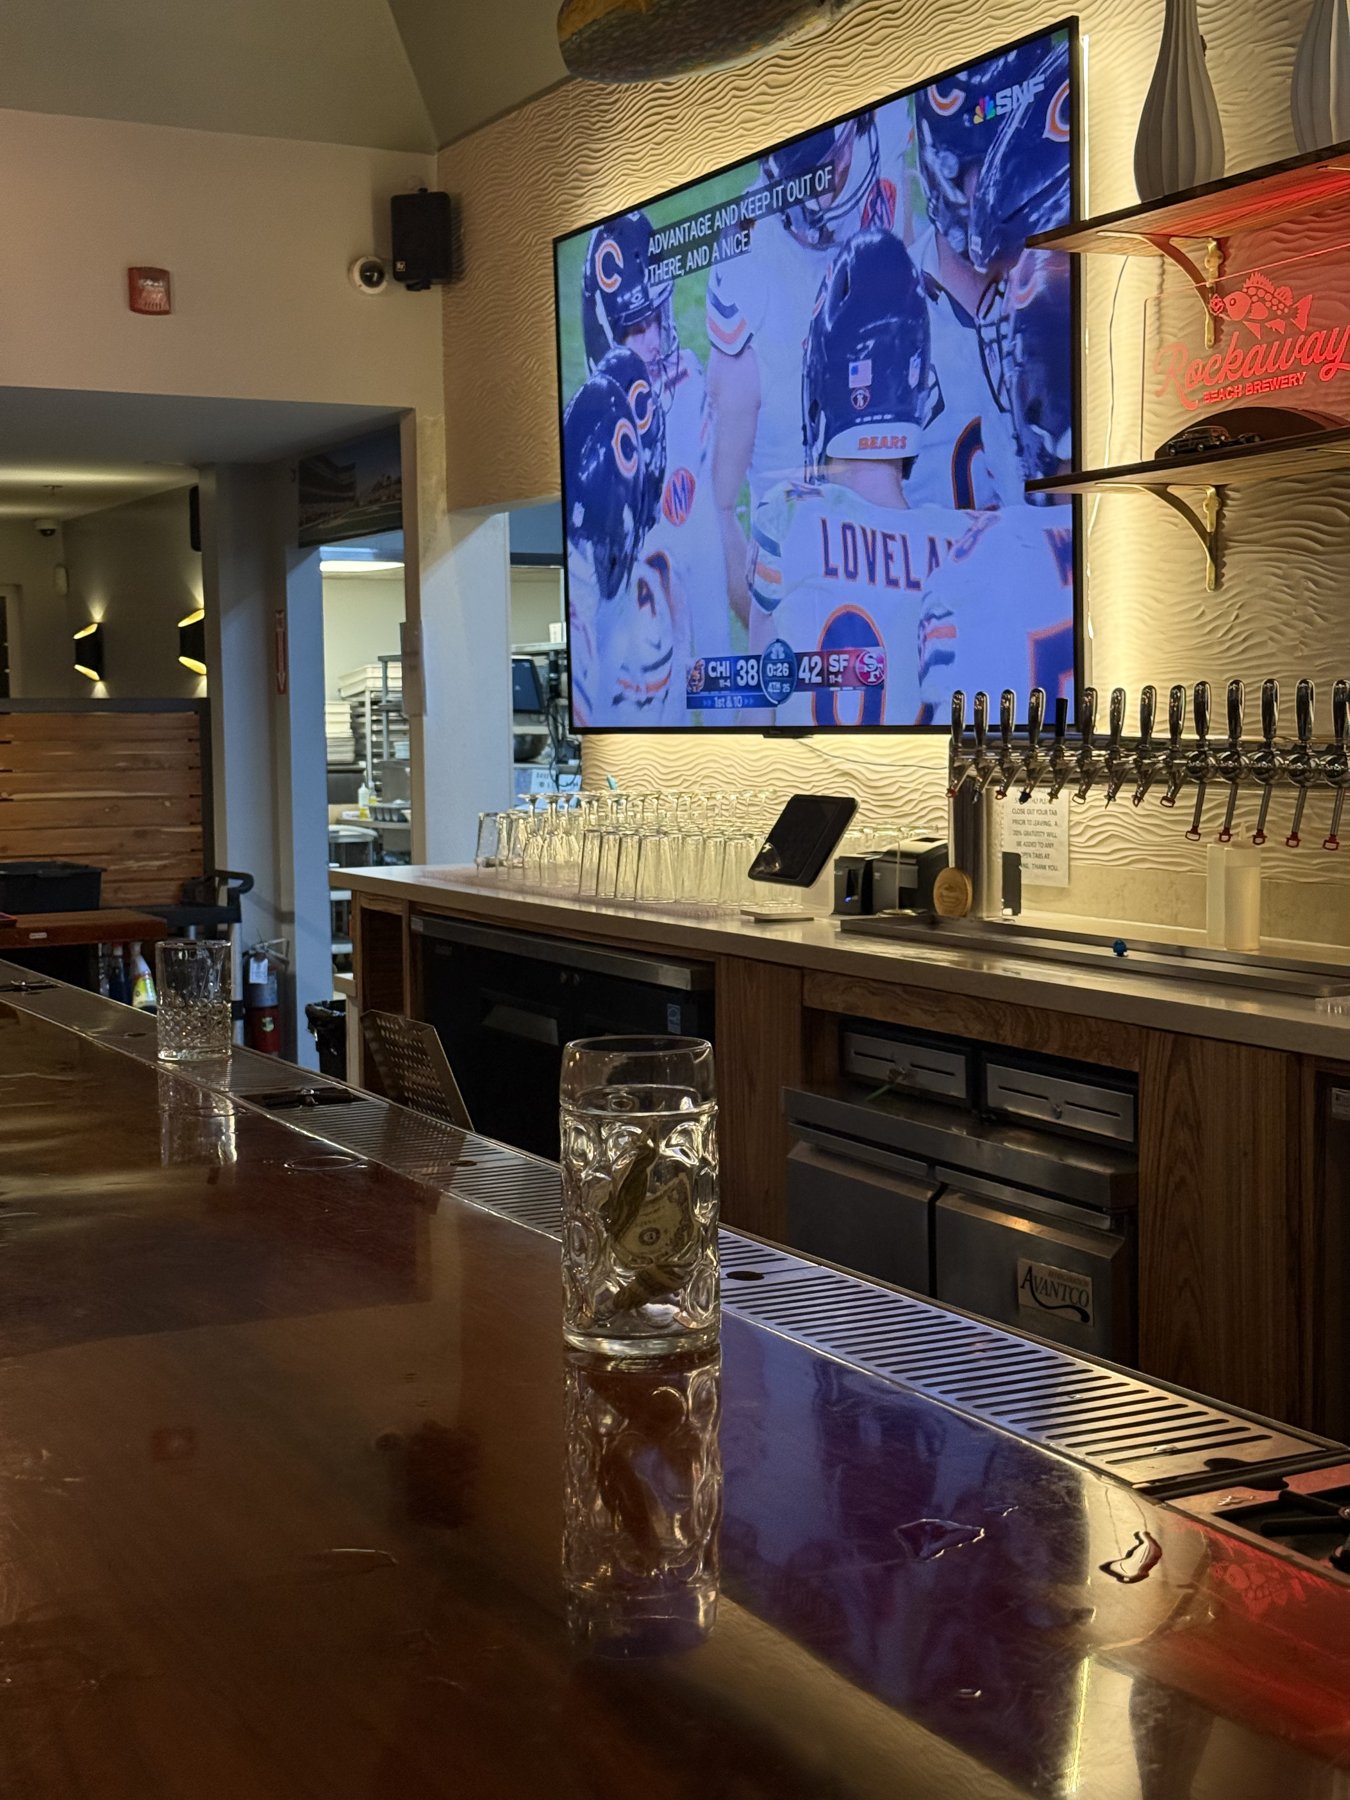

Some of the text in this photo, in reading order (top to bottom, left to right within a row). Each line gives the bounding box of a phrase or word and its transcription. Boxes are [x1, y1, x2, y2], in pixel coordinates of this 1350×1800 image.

[996, 74, 1045, 115] SNF
[648, 166, 832, 256] ADVANTAGE AND KEEP IT OUT OF
[648, 230, 749, 284] THERE, AND A NICE
[1153, 326, 1350, 411] Rockaway
[1203, 371, 1306, 404] BEACH BREWERY
[858, 435, 908, 450] BEARS
[821, 516, 955, 592] LOVELA
[708, 660, 730, 678] CHI
[736, 658, 759, 687] 38
[767, 662, 790, 677] 0:26
[798, 655, 823, 684] 42
[829, 654, 850, 673] SF
[1020, 1265, 1090, 1311] AVANTCO
